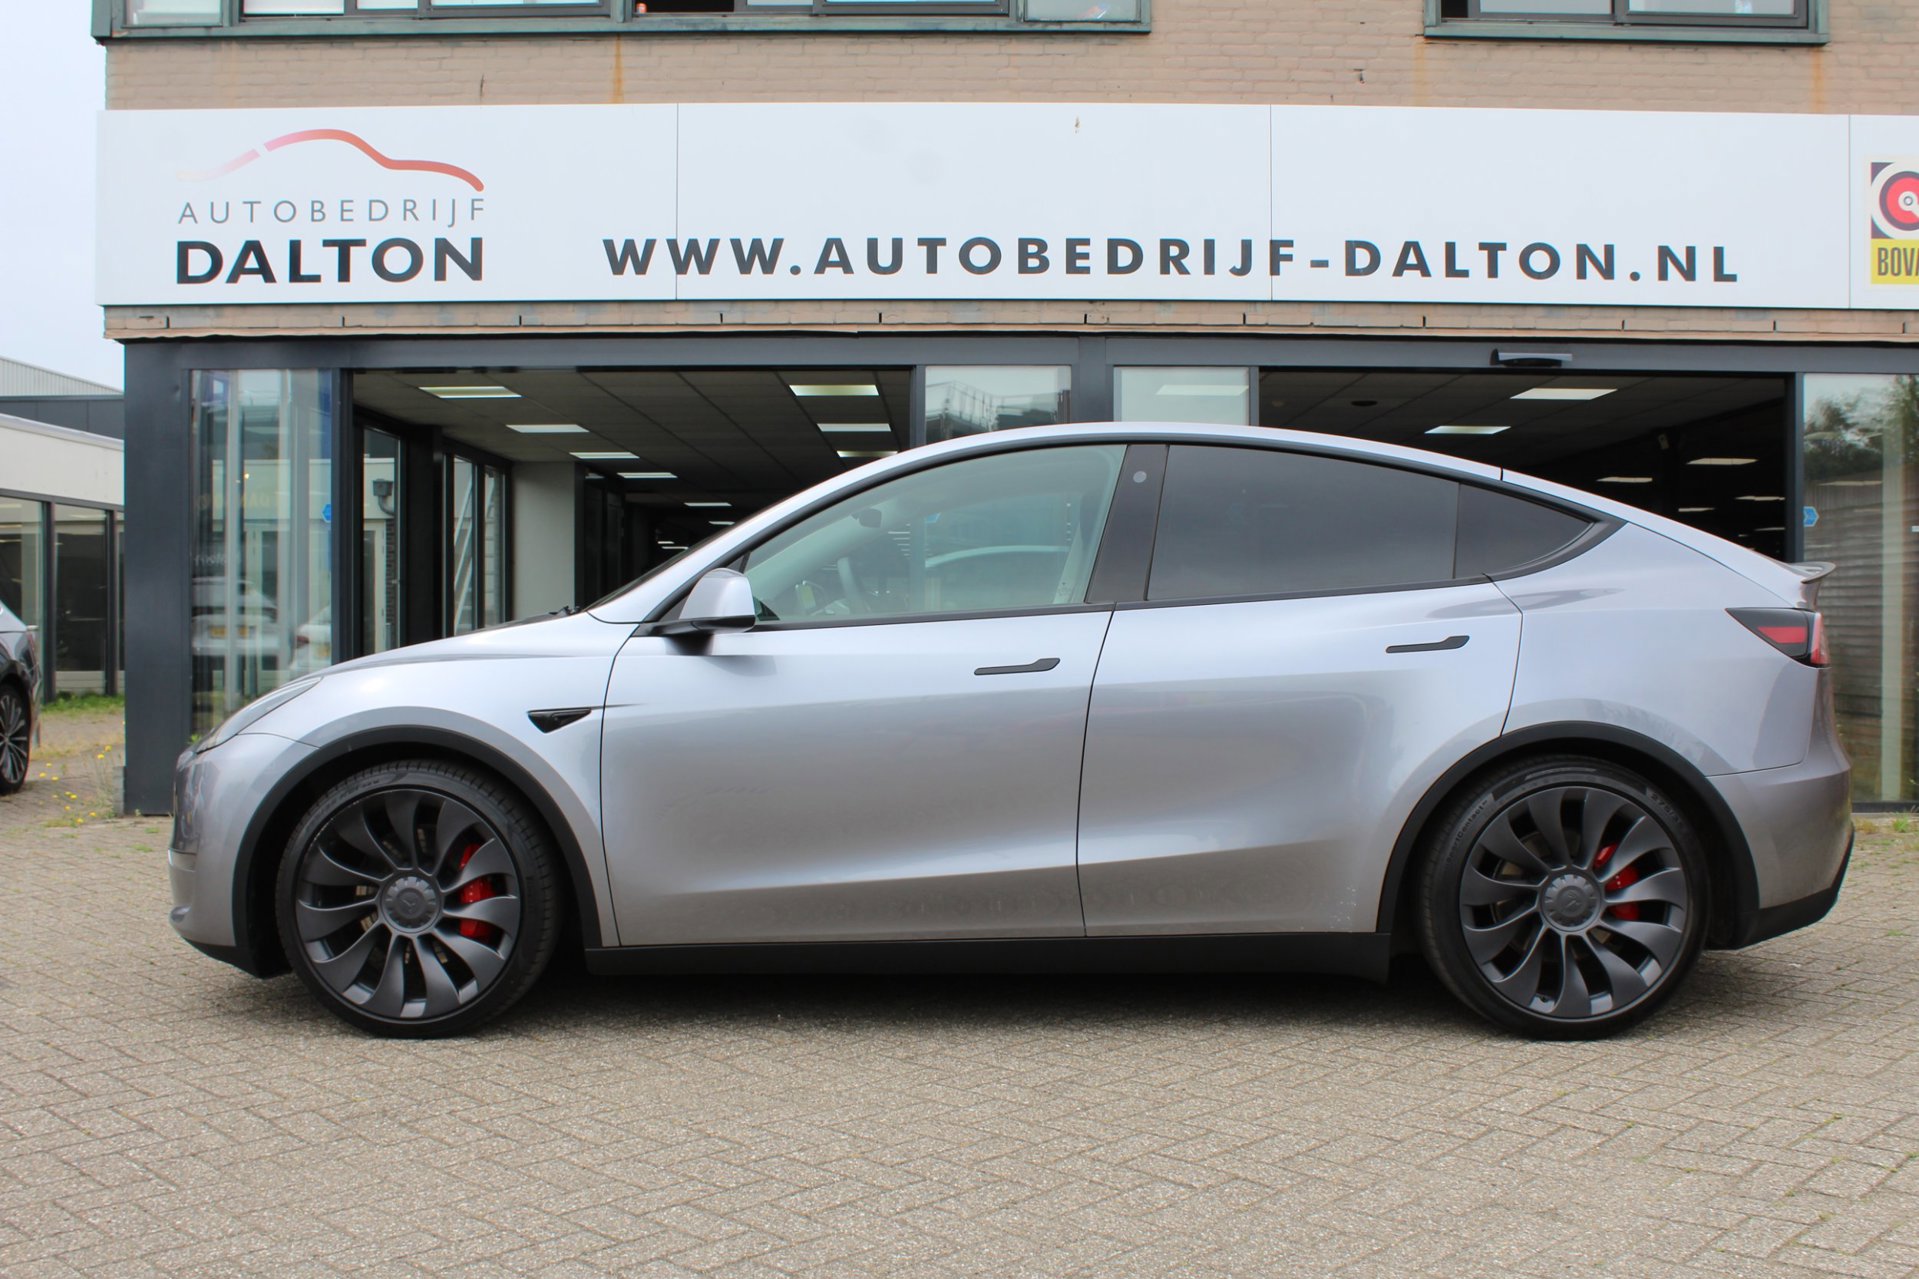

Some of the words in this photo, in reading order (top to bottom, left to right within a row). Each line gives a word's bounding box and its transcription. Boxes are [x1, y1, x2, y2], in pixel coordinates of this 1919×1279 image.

[178, 198, 484, 228] AUTOBEDRIJF
[176, 237, 483, 285] DALTON
[602, 237, 1738, 283] WWW.AUTOBEDRIJF-DALTON.NL
